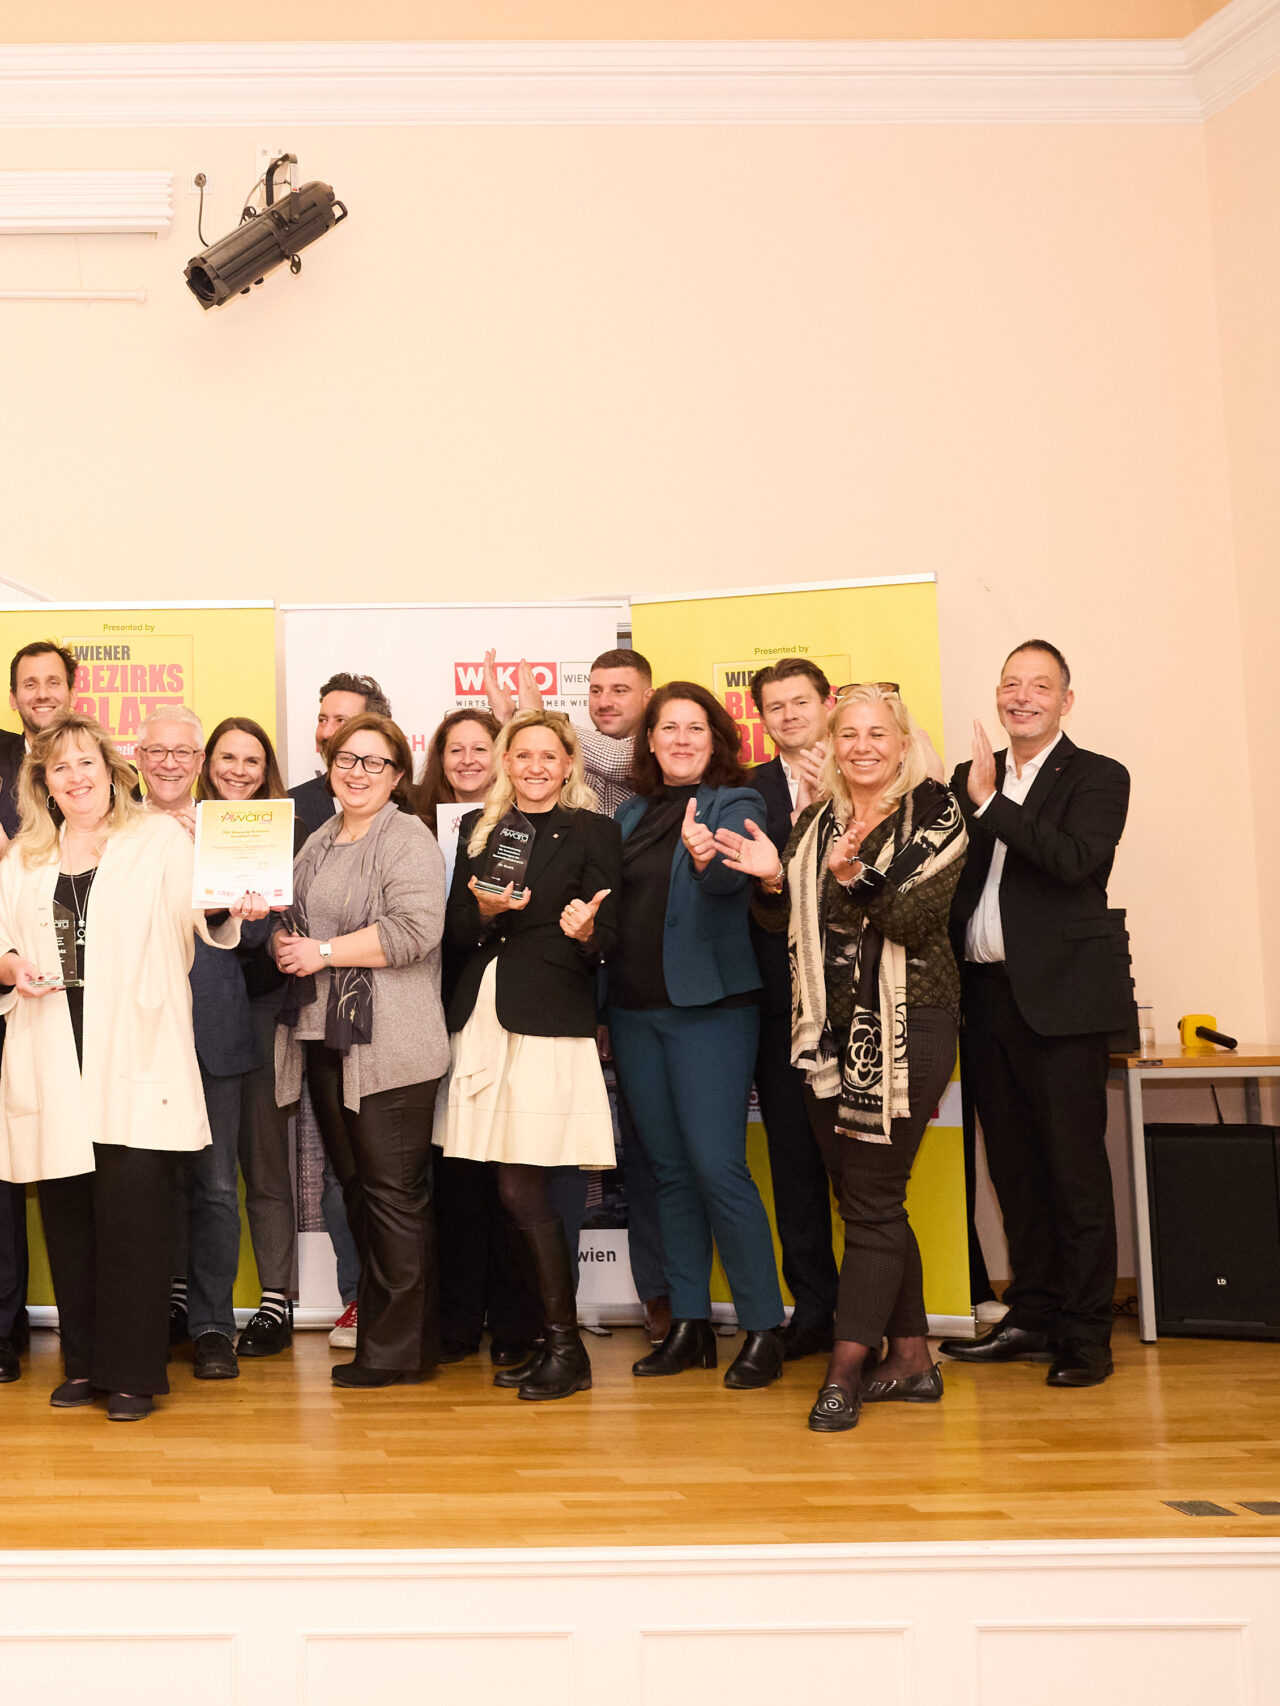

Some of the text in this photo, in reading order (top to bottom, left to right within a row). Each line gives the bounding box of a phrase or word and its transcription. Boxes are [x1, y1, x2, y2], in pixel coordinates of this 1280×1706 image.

[103, 624, 155, 633] Presented by
[74, 645, 131, 661] WIENER
[754, 645, 809, 655] Presented by
[75, 663, 184, 693] BEZIRKS
[456, 666, 590, 691] WKO WIEN
[221, 811, 273, 822] Award
